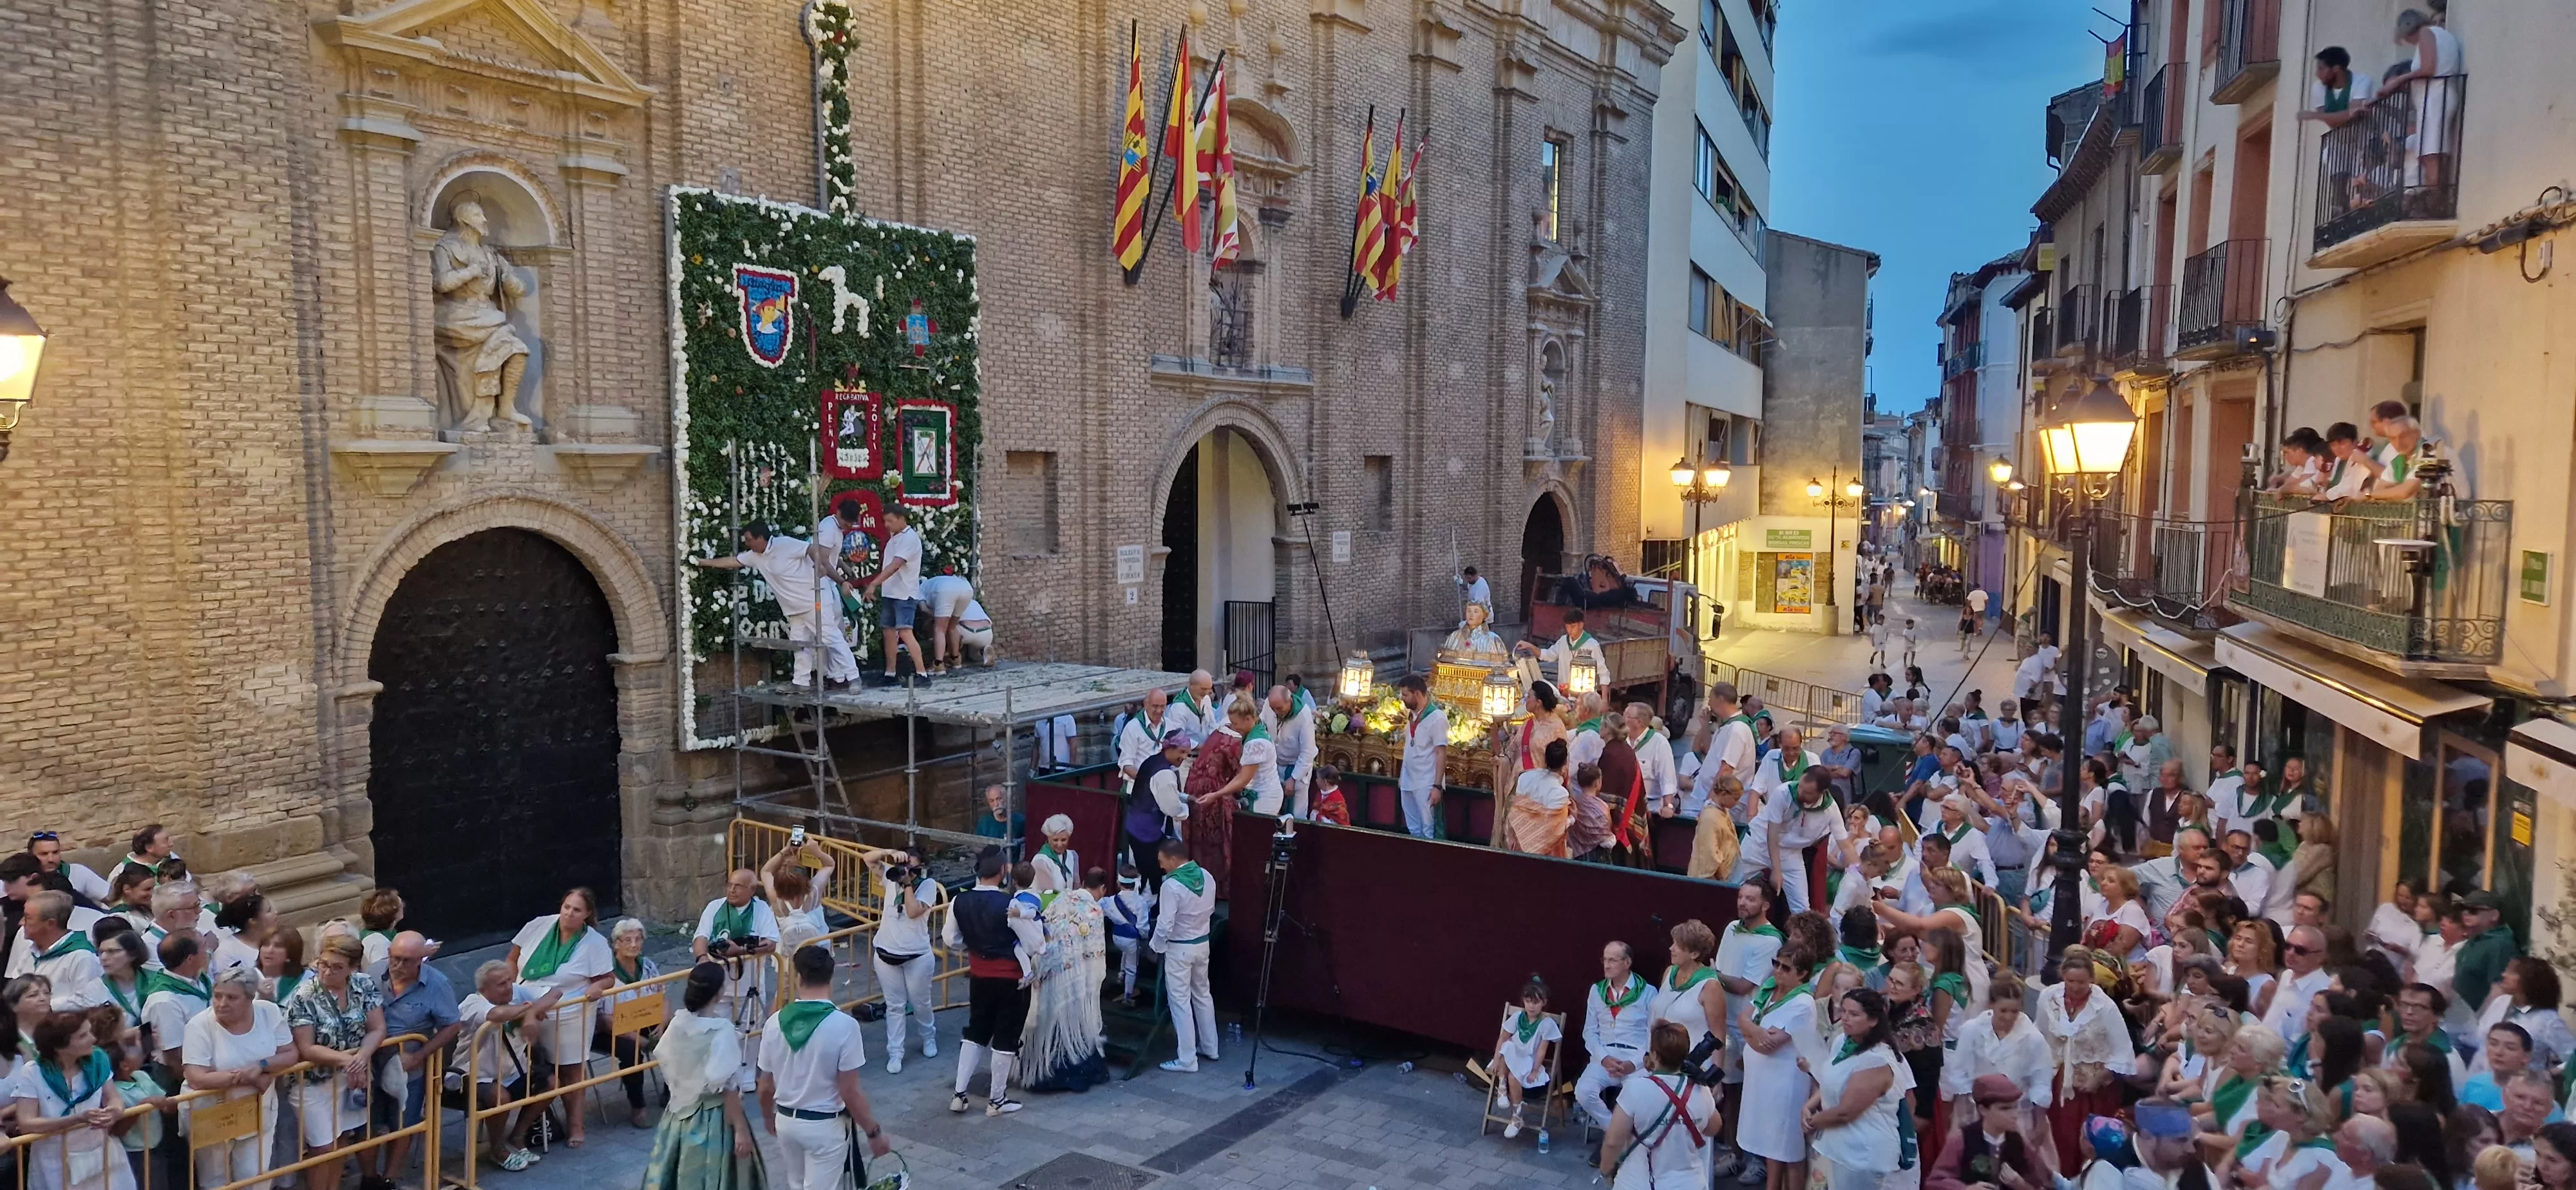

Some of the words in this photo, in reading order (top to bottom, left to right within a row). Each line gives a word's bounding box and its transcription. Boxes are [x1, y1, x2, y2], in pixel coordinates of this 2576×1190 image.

[835, 393, 869, 401] RECREATIVA
[862, 514, 876, 528] ÑA
[851, 534, 862, 547] LA
[1130, 591, 1134, 601] 2
